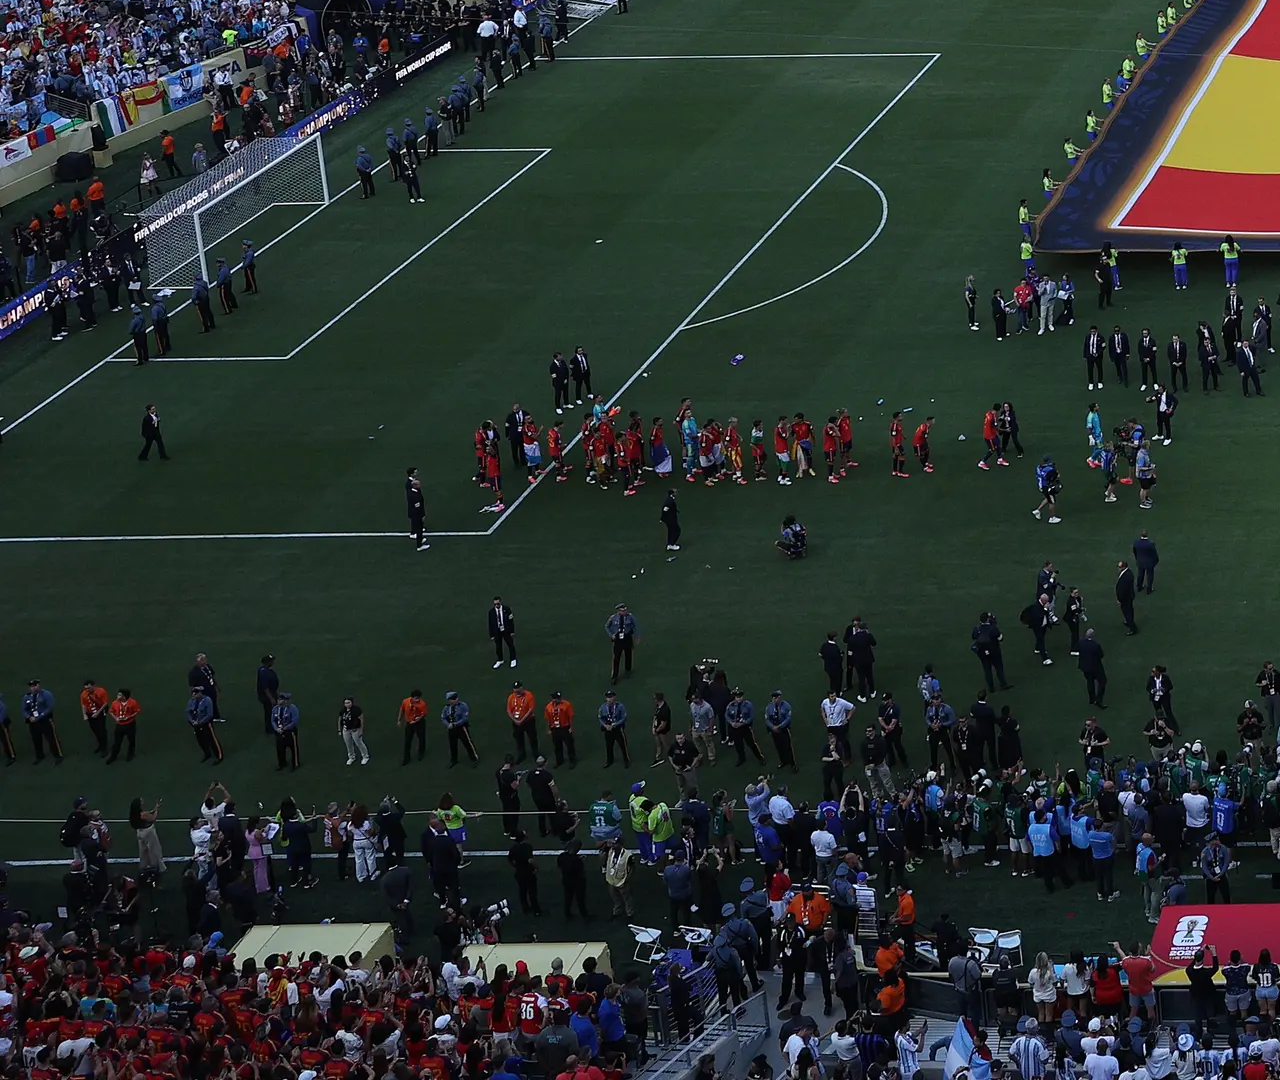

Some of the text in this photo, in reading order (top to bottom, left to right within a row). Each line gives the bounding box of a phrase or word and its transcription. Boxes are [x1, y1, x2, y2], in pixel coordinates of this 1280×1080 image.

[407, 58, 426, 73] WORLD
[298, 102, 349, 138] CHAMPIONS
[134, 190, 209, 242] FIFA WORLD CUP 2026
[1258, 972, 1272, 988] 10
[520, 1002, 535, 1020] 36
